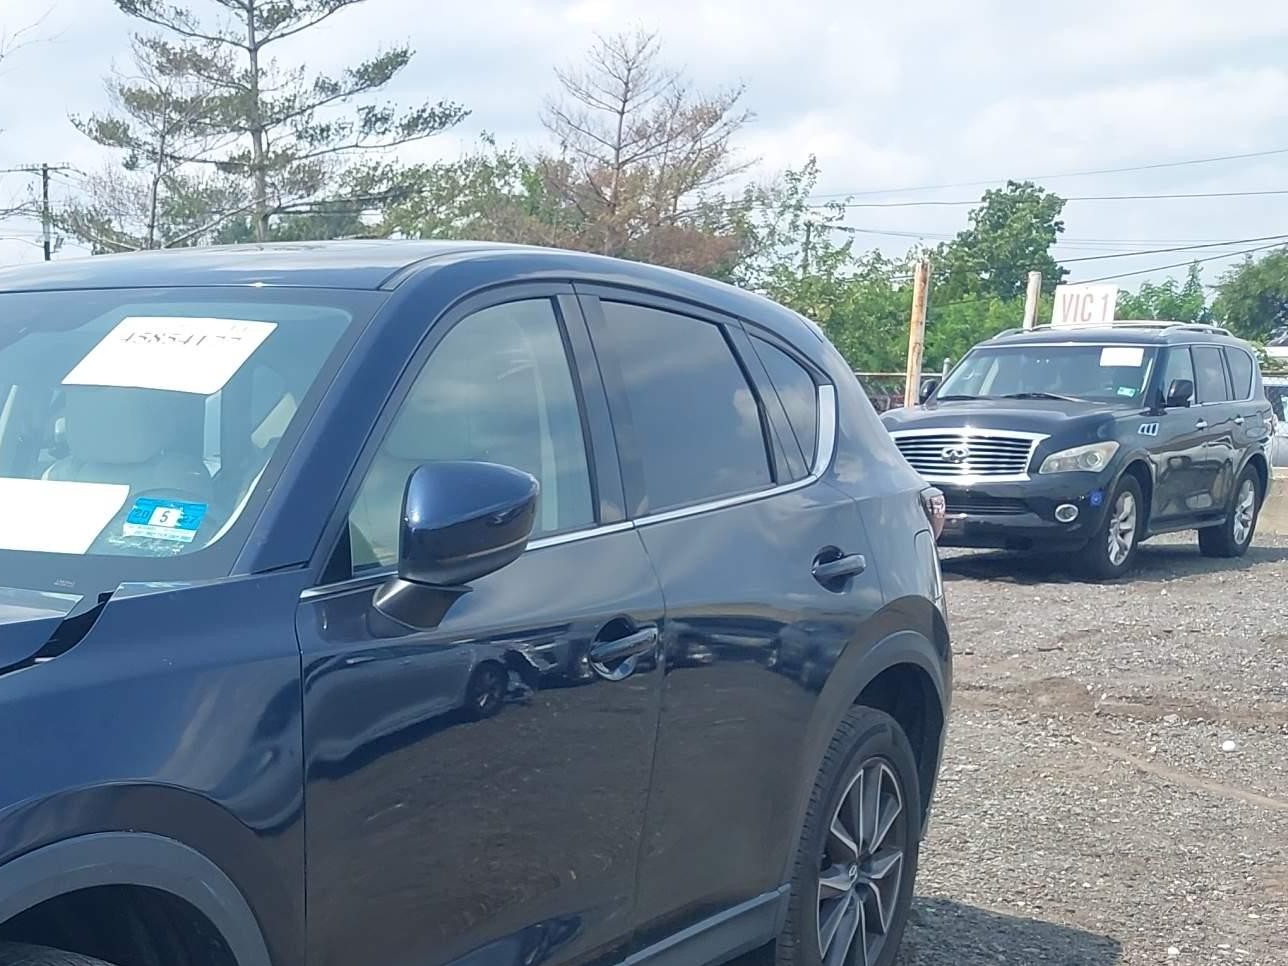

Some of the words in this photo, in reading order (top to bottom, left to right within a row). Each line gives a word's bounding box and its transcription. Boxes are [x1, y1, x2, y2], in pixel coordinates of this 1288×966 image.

[1062, 293, 1094, 322] VIC
[1101, 293, 1109, 322] 1
[160, 511, 170, 523] 5
